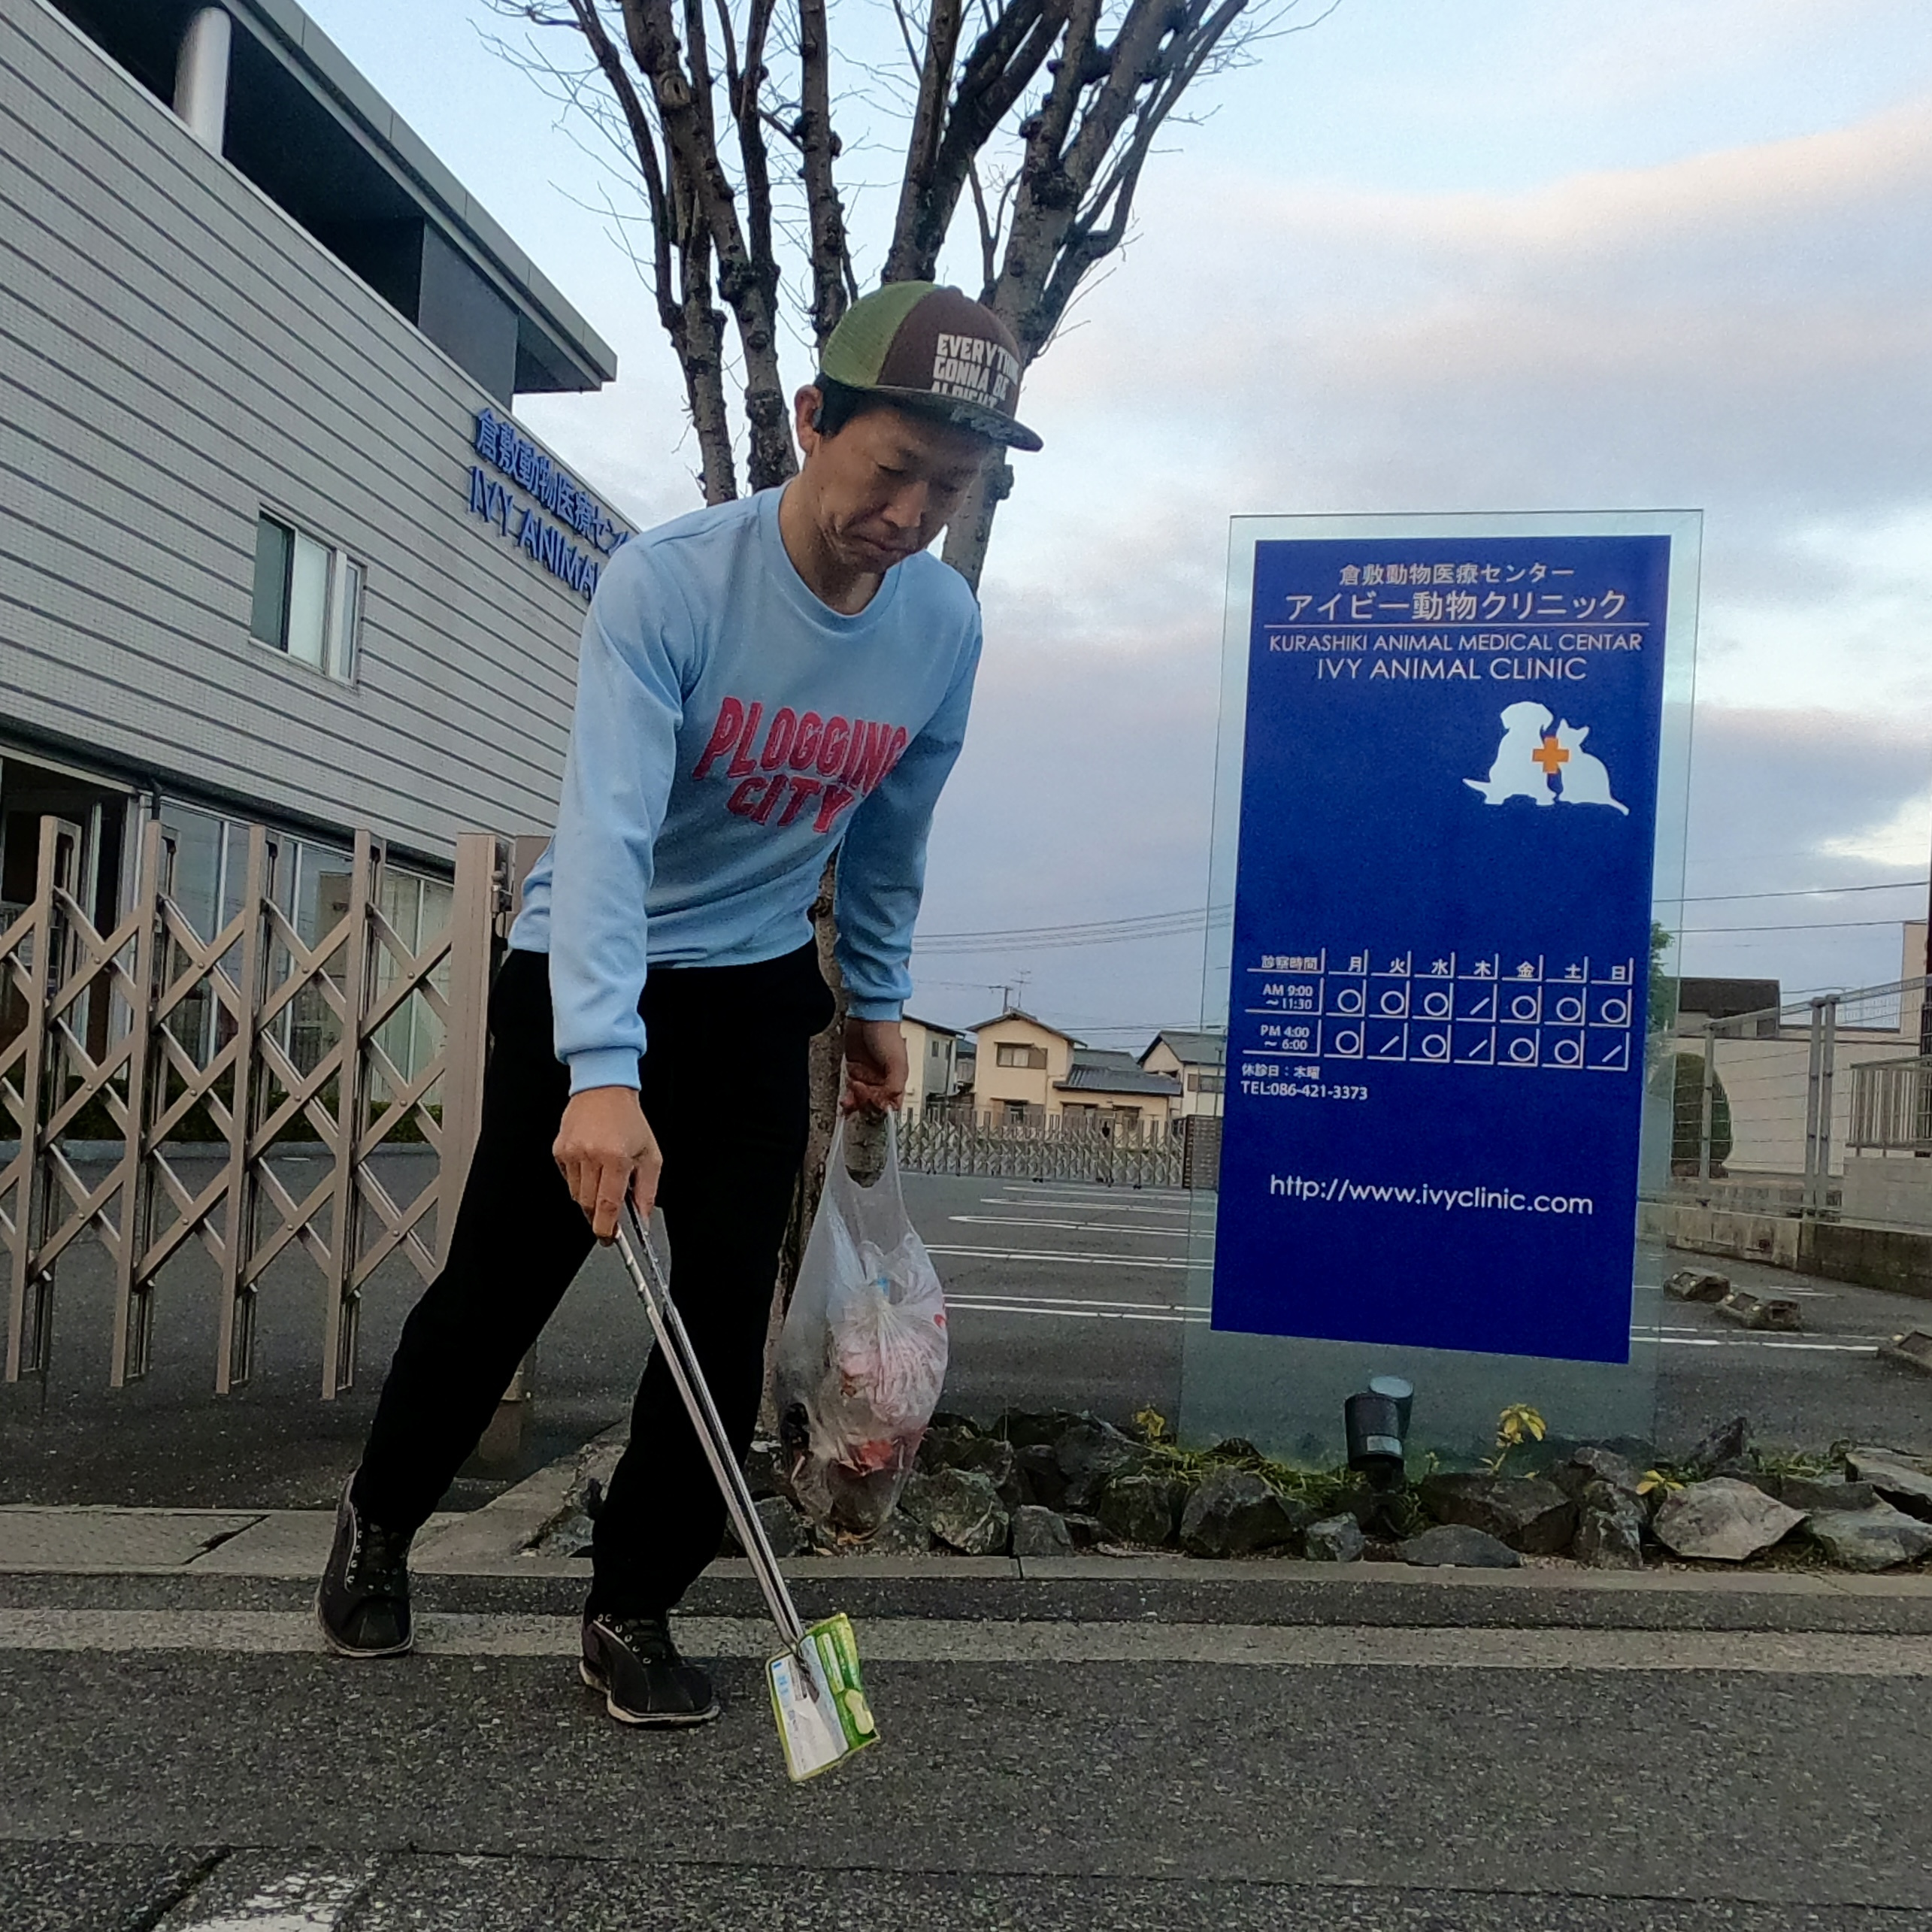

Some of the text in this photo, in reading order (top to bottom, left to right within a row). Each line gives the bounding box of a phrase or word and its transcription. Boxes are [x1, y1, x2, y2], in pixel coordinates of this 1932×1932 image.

[933, 356, 1010, 401] GONNA BE
[470, 466, 513, 537] IVY
[1339, 562, 1574, 586] 倉敷動物医療センター
[1285, 589, 1626, 622] アイビー動物クリニック
[1269, 633, 1643, 652] KURASHIKI ANIMAL MEDICAL CENTAR
[1318, 657, 1588, 680] IVY ANIMAL CLINIC
[692, 695, 909, 798] PLOGGING
[726, 774, 855, 834] CITY
[1261, 955, 1626, 981] 診察時間 月 火 水 木 金 土 日
[1262, 983, 1313, 997] AM 9:00
[1260, 1024, 1310, 1038] PM 4:00
[1240, 1080, 1368, 1101] TEL:086-421-3373
[1269, 1173, 1593, 1215] http://www.ivyclinic.com
